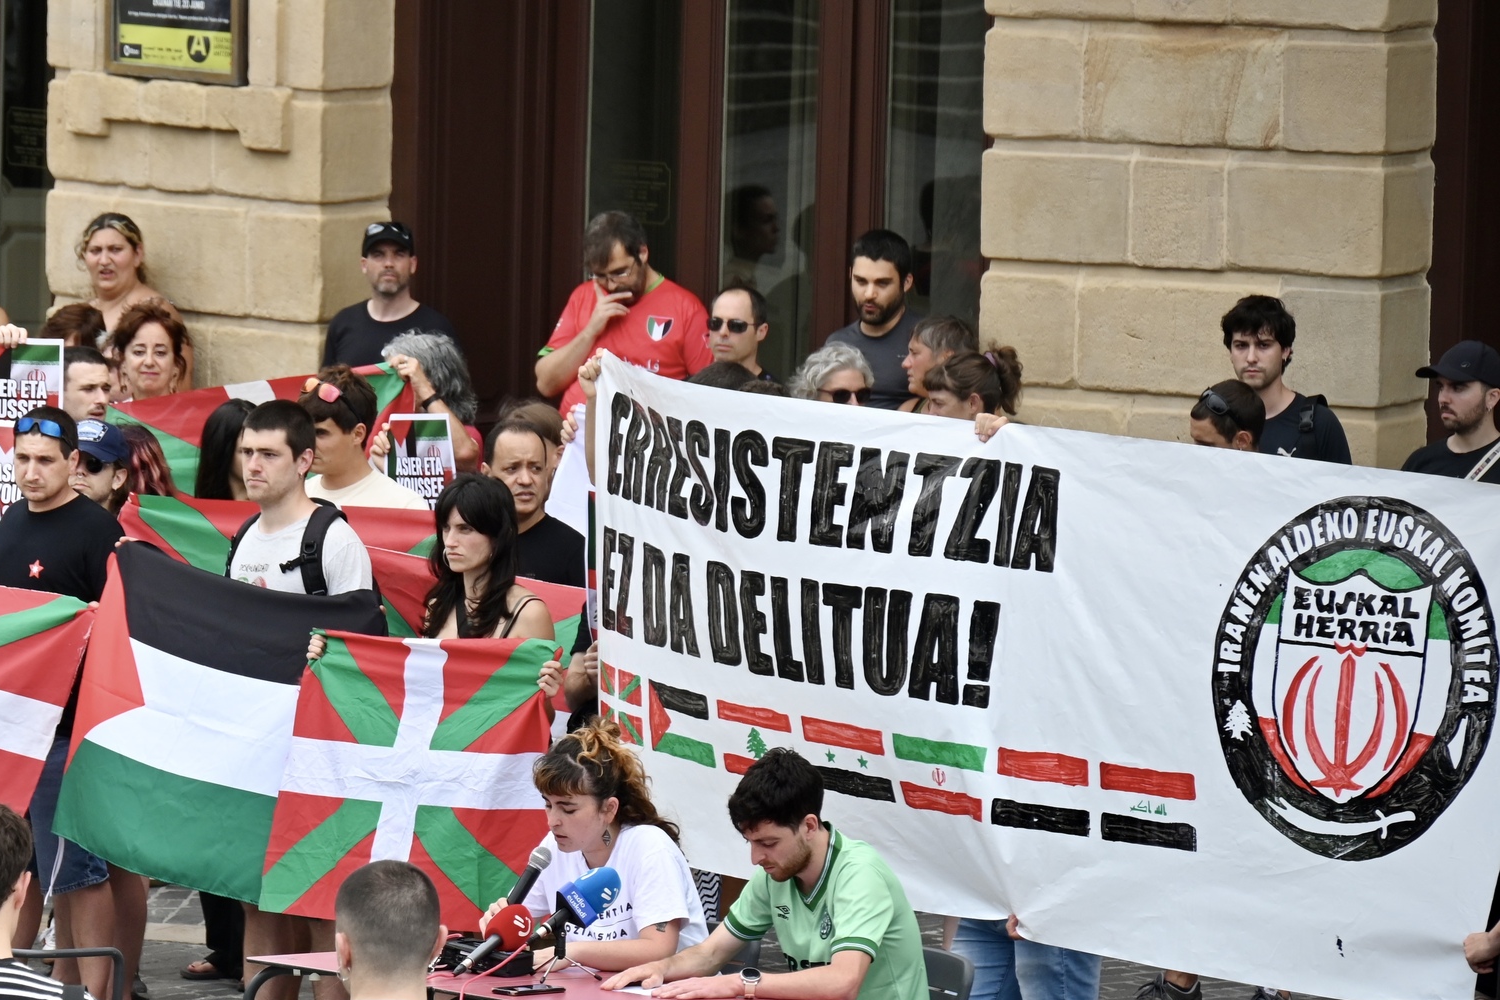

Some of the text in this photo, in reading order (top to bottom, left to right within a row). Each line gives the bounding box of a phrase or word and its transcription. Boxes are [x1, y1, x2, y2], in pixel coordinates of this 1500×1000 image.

[20, 380, 48, 400] ETA
[396, 457, 444, 476] ASIER ETA
[607, 391, 1061, 573] ERRESISTENTZIA
[1217, 563, 1272, 673] IRANEN
[1365, 508, 1454, 578] EUSKAL
[1442, 568, 1492, 704] KOMITEA
[1293, 586, 1420, 619] EUSKAL
[602, 525, 1001, 709] EZ DA DELITUA!
[567, 895, 587, 919] euskadi
[571, 890, 586, 908] radio
